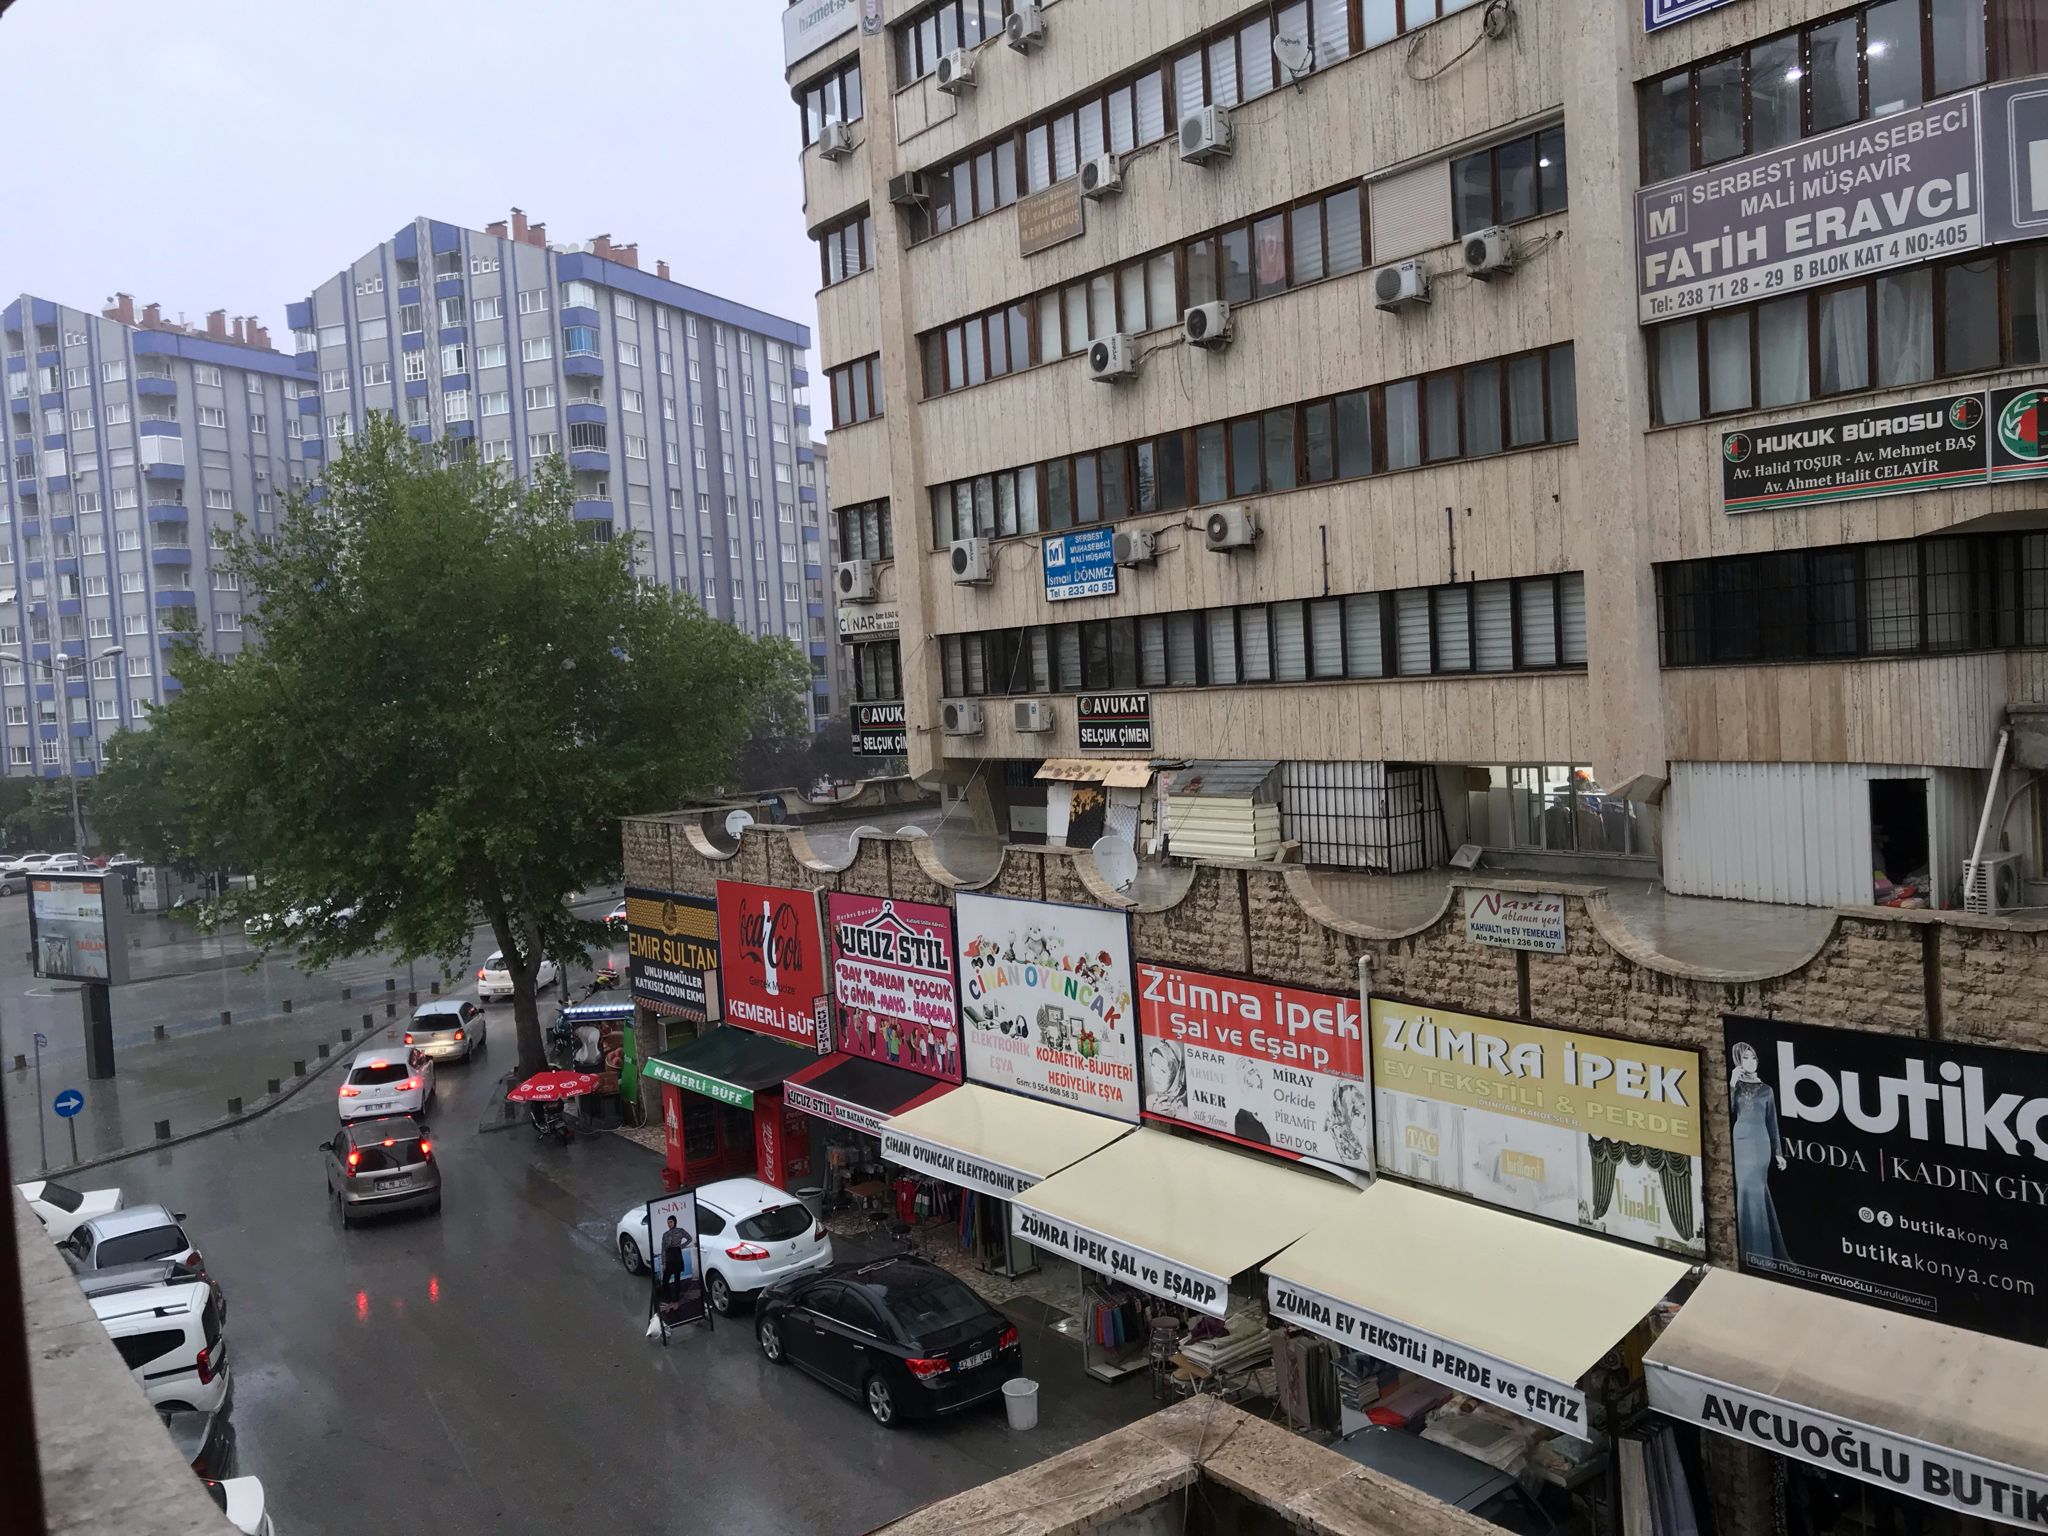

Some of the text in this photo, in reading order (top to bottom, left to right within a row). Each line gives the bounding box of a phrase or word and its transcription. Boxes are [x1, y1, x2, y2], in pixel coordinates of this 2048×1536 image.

[1692, 103, 1968, 204] SERBEST MUHASEBECİ
[1741, 154, 1912, 217] MALİ MÜŞAVİR
[1646, 226, 1767, 287] FATİH
[1785, 172, 1970, 254] ERAVCI
[1650, 224, 1968, 314] Tel: 238 71 28 29 B BLOK KAT 4 NO:405
[1757, 411, 1943, 454] HUKUK BÜROSU
[1733, 434, 1976, 480] Av. Halid TOŞUR Av. Mehmet BAŞ
[1764, 459, 1939, 494] Av. Ahmet Halit CELAYİR
[1070, 539, 1111, 554] MUHASEBECİ
[1075, 531, 1103, 544] SERBEST
[1047, 566, 1114, 586] İsmail DÖNMEZ
[1071, 555, 1085, 564] MALİ
[1068, 585, 1085, 596] 233
[1087, 584, 1099, 593] 40
[1102, 582, 1114, 592] 95
[871, 707, 904, 724] AVUK
[1094, 697, 1146, 713] AVUKAT
[863, 736, 893, 753] SELÇUK
[1081, 725, 1149, 747] SELÇUK ÇİMEN
[1470, 893, 1561, 919] Navin
[1501, 910, 1561, 928] ablanın yeri
[1470, 922, 1502, 934] KAHVALTI
[1511, 926, 1521, 936] EV
[1522, 928, 1561, 940] YEMEKLERİ
[1475, 934, 1556, 949] Alo Paket 236 08 07
[629, 932, 718, 970] EMİR SULTAN
[842, 926, 949, 972] UCUZ STİL
[635, 977, 664, 994] KATKISIZ
[664, 984, 686, 999] ODUN
[644, 965, 702, 989] UNLU MAMÜLLER
[913, 979, 953, 1002] ÇOCUK
[1024, 965, 1121, 1030] OYUNCAK
[1142, 969, 1360, 1041] Zümra ipek
[729, 999, 815, 1036] KEMERLİ BÜF
[1170, 1013, 1330, 1069] Şal ve Eşarp
[1187, 1048, 1225, 1065] SARAR
[1273, 1068, 1314, 1089] MİRAY
[1382, 1015, 1690, 1108] ZÜMRA İPEK
[654, 1067, 743, 1104] KEMERLİ BÜFE
[1048, 1070, 1124, 1102] HEDİYELİK EŞYA
[1070, 1091, 1079, 1101] 33
[1192, 1089, 1227, 1109] AKER
[1273, 1089, 1316, 1110] Orkide
[1383, 1061, 1415, 1080] EV
[1422, 1066, 1543, 1109] TEKSTİLİ
[1555, 1096, 1577, 1115] &
[1587, 1101, 1689, 1138] PERDE
[788, 1090, 811, 1109] UCUZ
[812, 1098, 832, 1116] STİL
[847, 1110, 865, 1125] BAYAN
[865, 1117, 882, 1130] ÇOCU
[1275, 1110, 1317, 1132] PİRAMİT
[1275, 1132, 1293, 1147] LEVI
[885, 1136, 1015, 1192] CİHAN OYUNCAK ELEKTRONİK
[1783, 1137, 1869, 1173] MODA
[1891, 1156, 1991, 1195] KADIN
[1899, 1215, 2009, 1251] butikakonya
[1020, 1213, 1217, 1306] ZÜMRA İPEK ŞAL ve EŞARP
[1750, 1256, 1778, 1270] Butika
[1779, 1262, 1806, 1277] Moda
[1807, 1269, 1820, 1280] bir
[1821, 1273, 1873, 1294] AVCUOĞLU
[1841, 1237, 2035, 1296] butikakonya.com
[1276, 1289, 1581, 1422] ZÜMRA EV TEKSTİLİ PERDE ve ÇEYİZ
[1701, 1393, 1910, 1485] AVCUOĞLU
